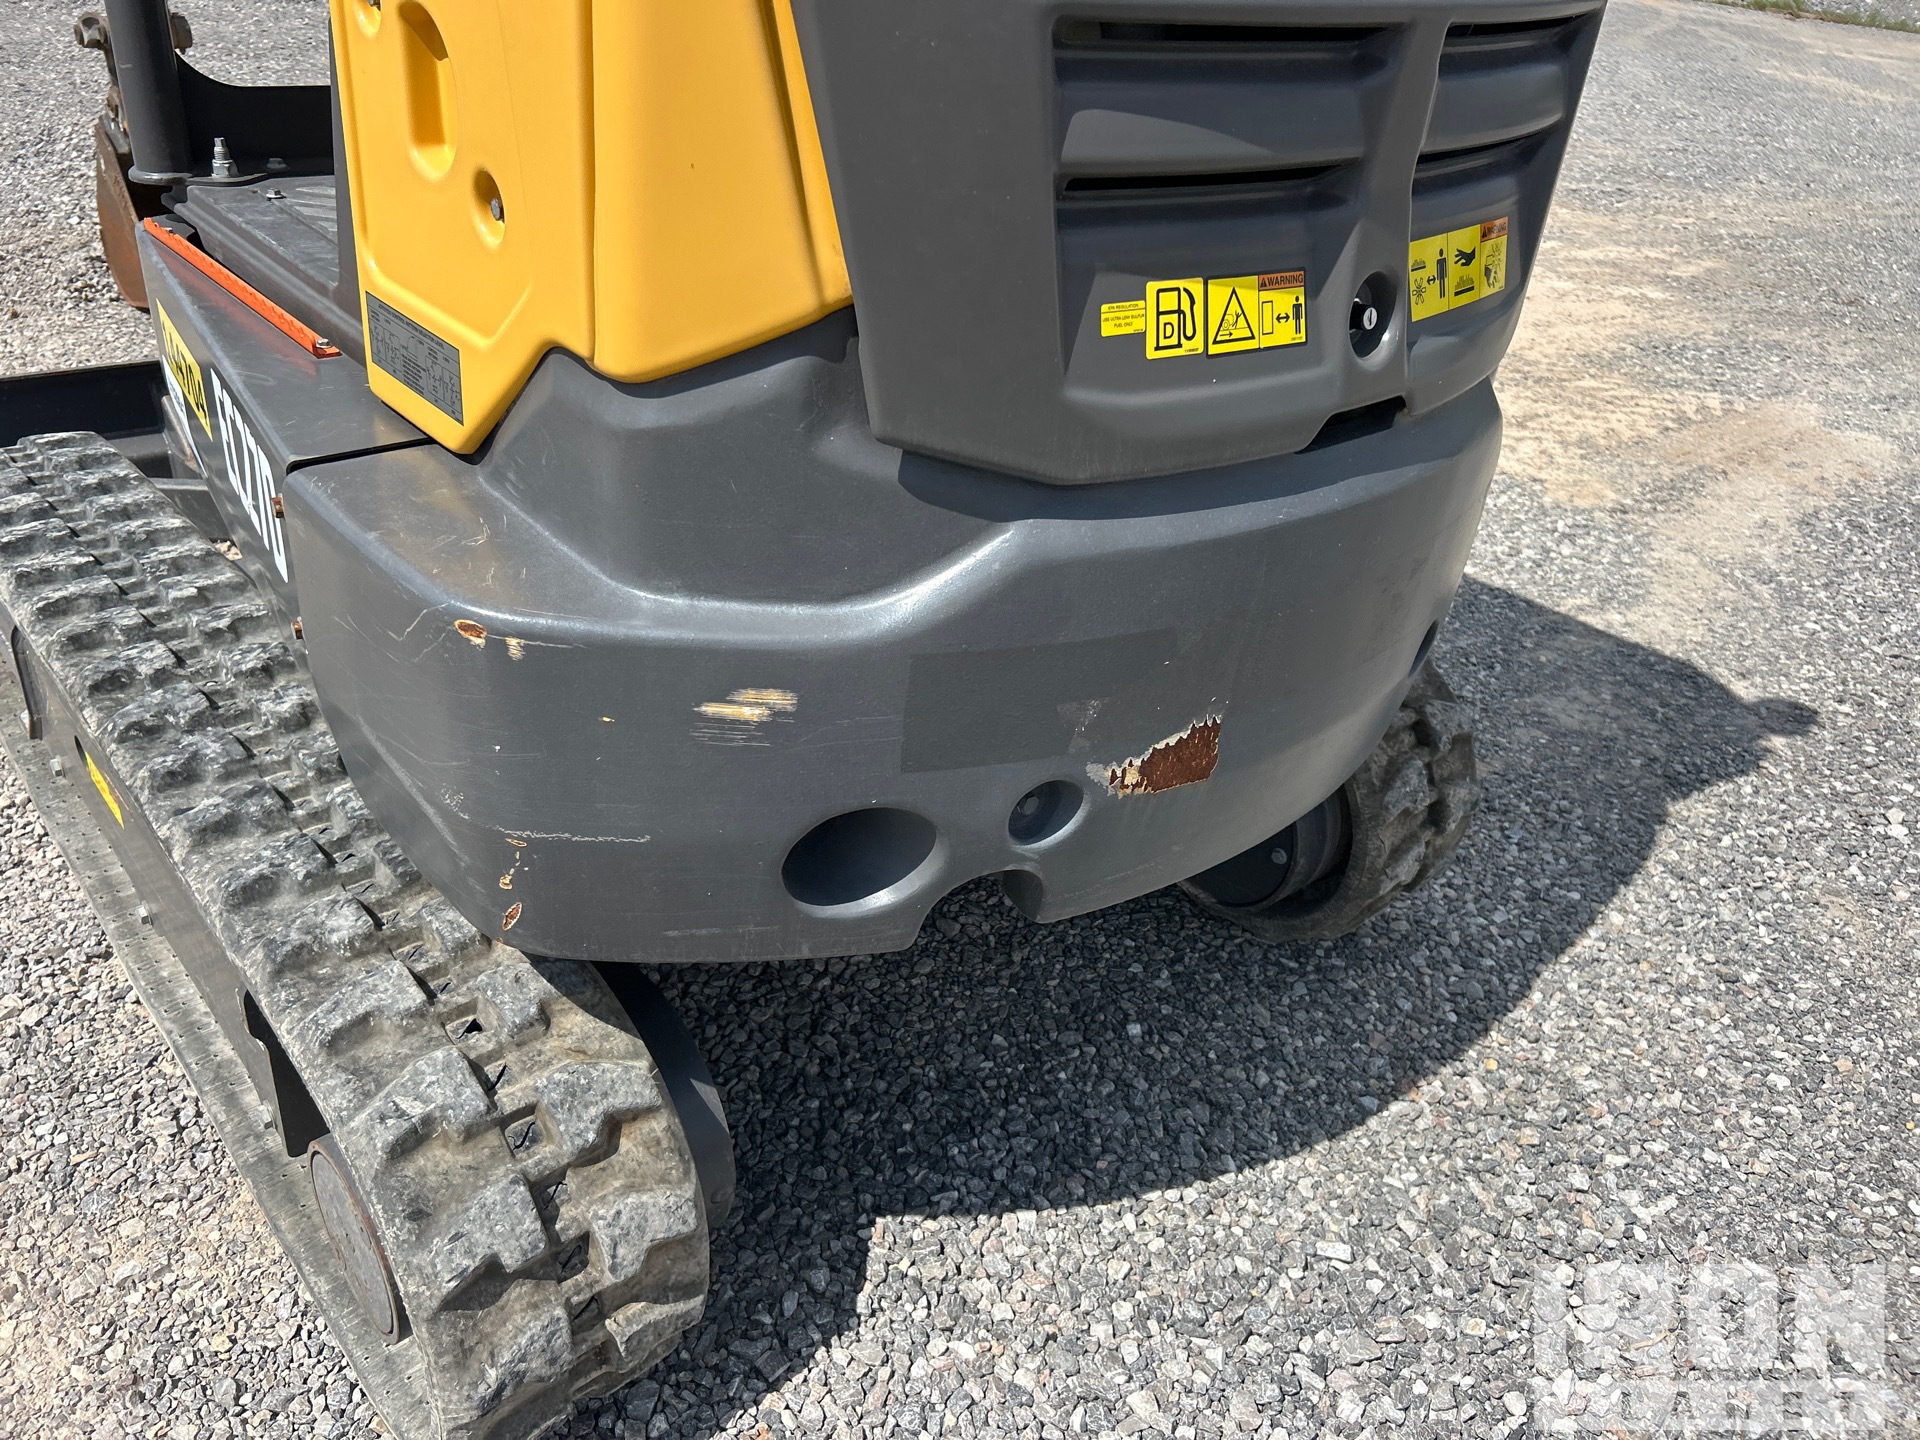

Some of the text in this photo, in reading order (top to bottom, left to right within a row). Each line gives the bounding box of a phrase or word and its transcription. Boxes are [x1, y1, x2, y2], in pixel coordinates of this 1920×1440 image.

[1267, 273, 1304, 286] WARNING
[1163, 322, 1175, 340] D
[210, 368, 289, 584] EC27D
